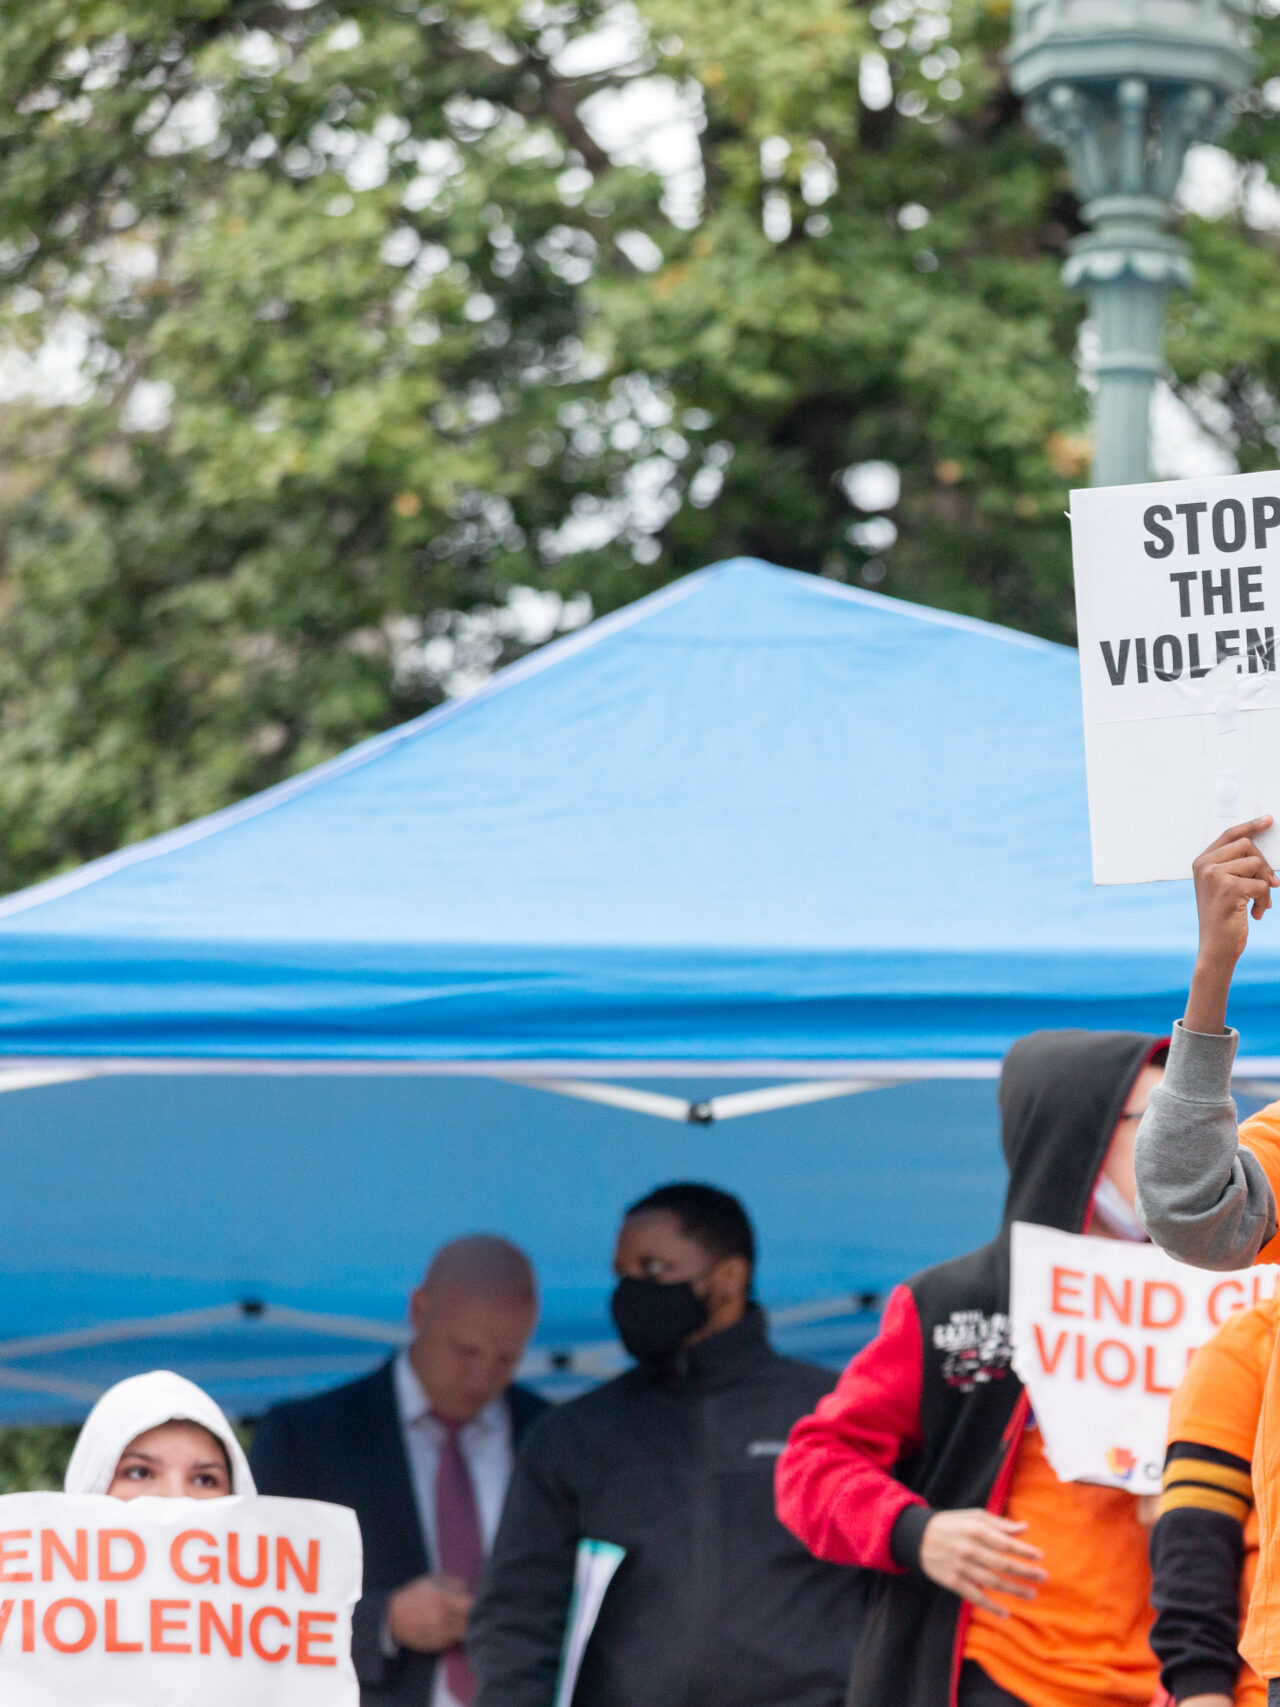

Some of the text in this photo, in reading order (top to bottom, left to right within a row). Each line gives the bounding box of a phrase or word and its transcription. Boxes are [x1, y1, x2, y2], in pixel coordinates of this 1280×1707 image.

[1170, 565, 1265, 618] THE
[1050, 1265, 1186, 1330] END
[0, 1528, 321, 1595] END GUN
